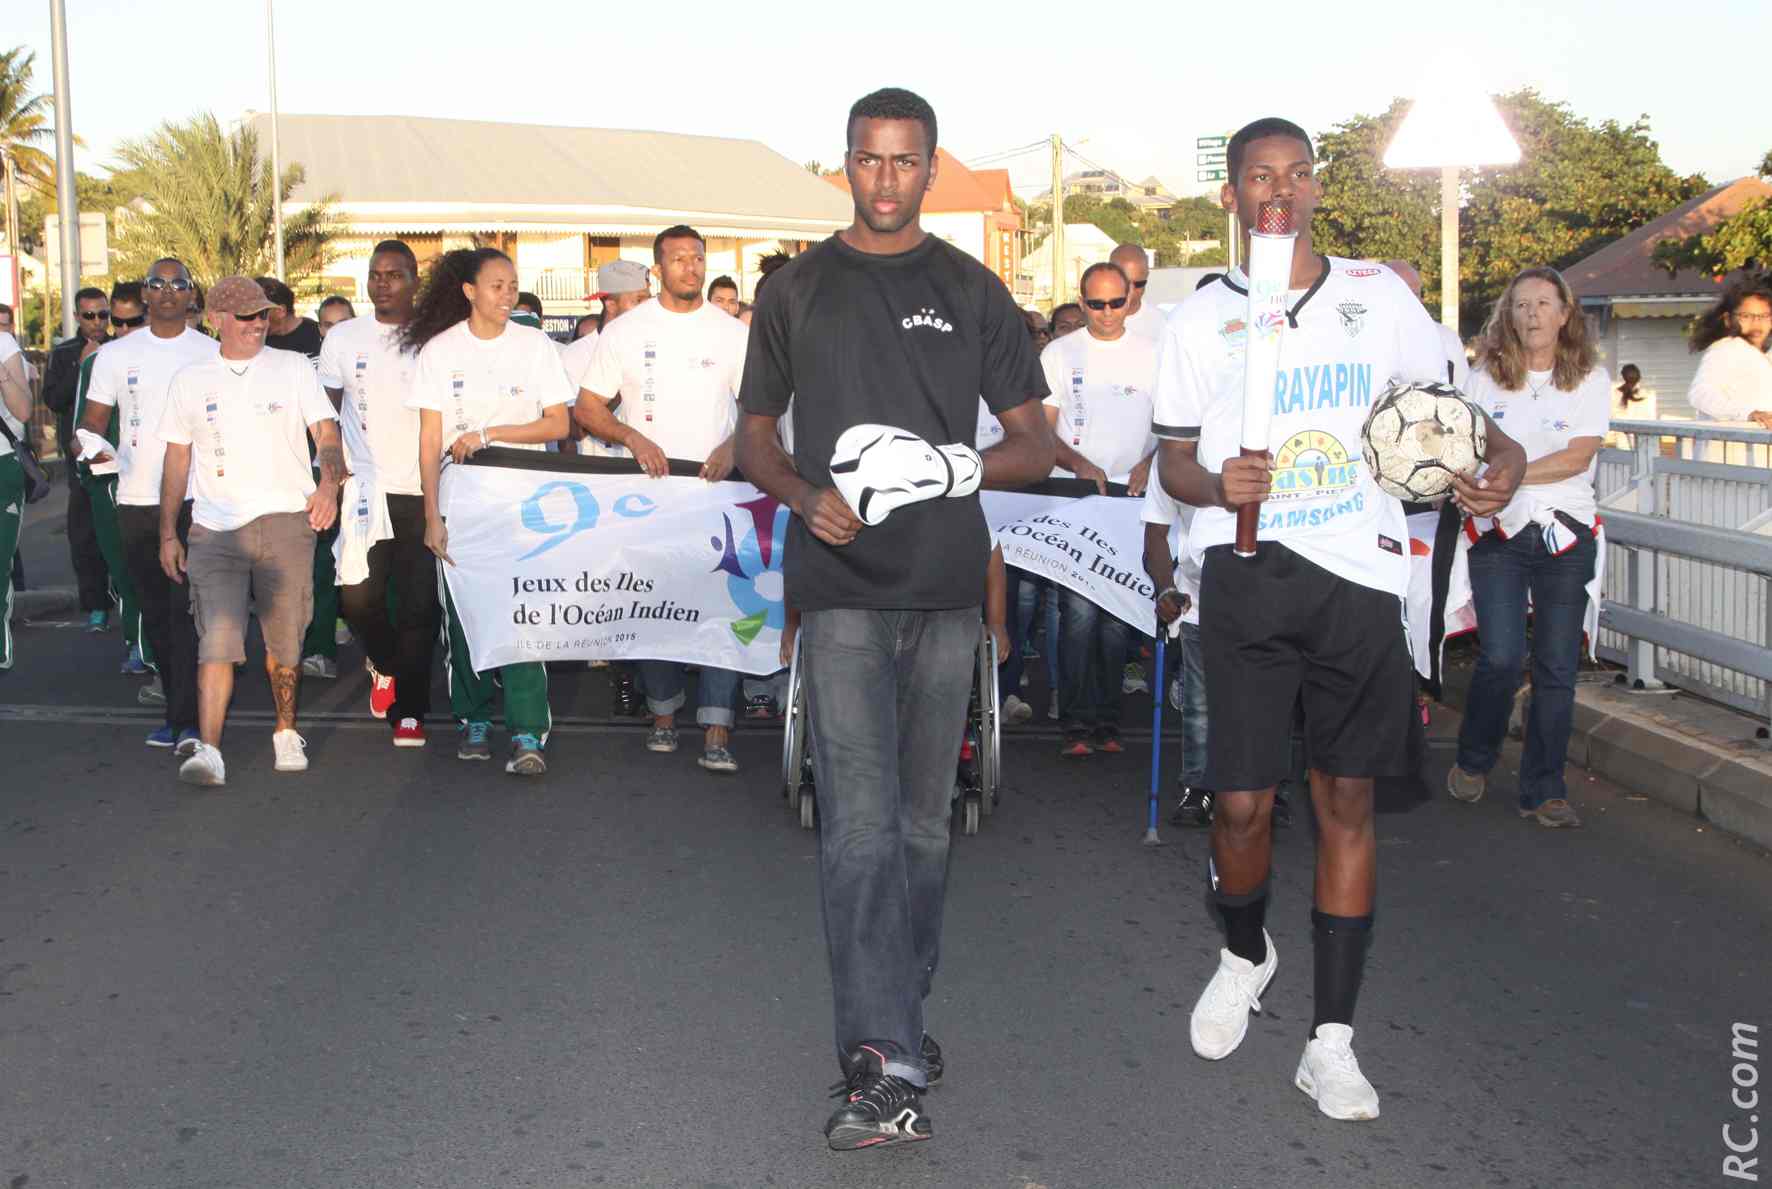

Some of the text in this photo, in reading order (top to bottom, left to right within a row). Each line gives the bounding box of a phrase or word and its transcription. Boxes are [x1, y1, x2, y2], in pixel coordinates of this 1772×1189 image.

[997, 524, 1083, 563] l'Océan
[1032, 514, 1117, 556] des Iles
[512, 571, 655, 599] Jeux des Iles
[512, 599, 701, 626] de l'Océan Indien
